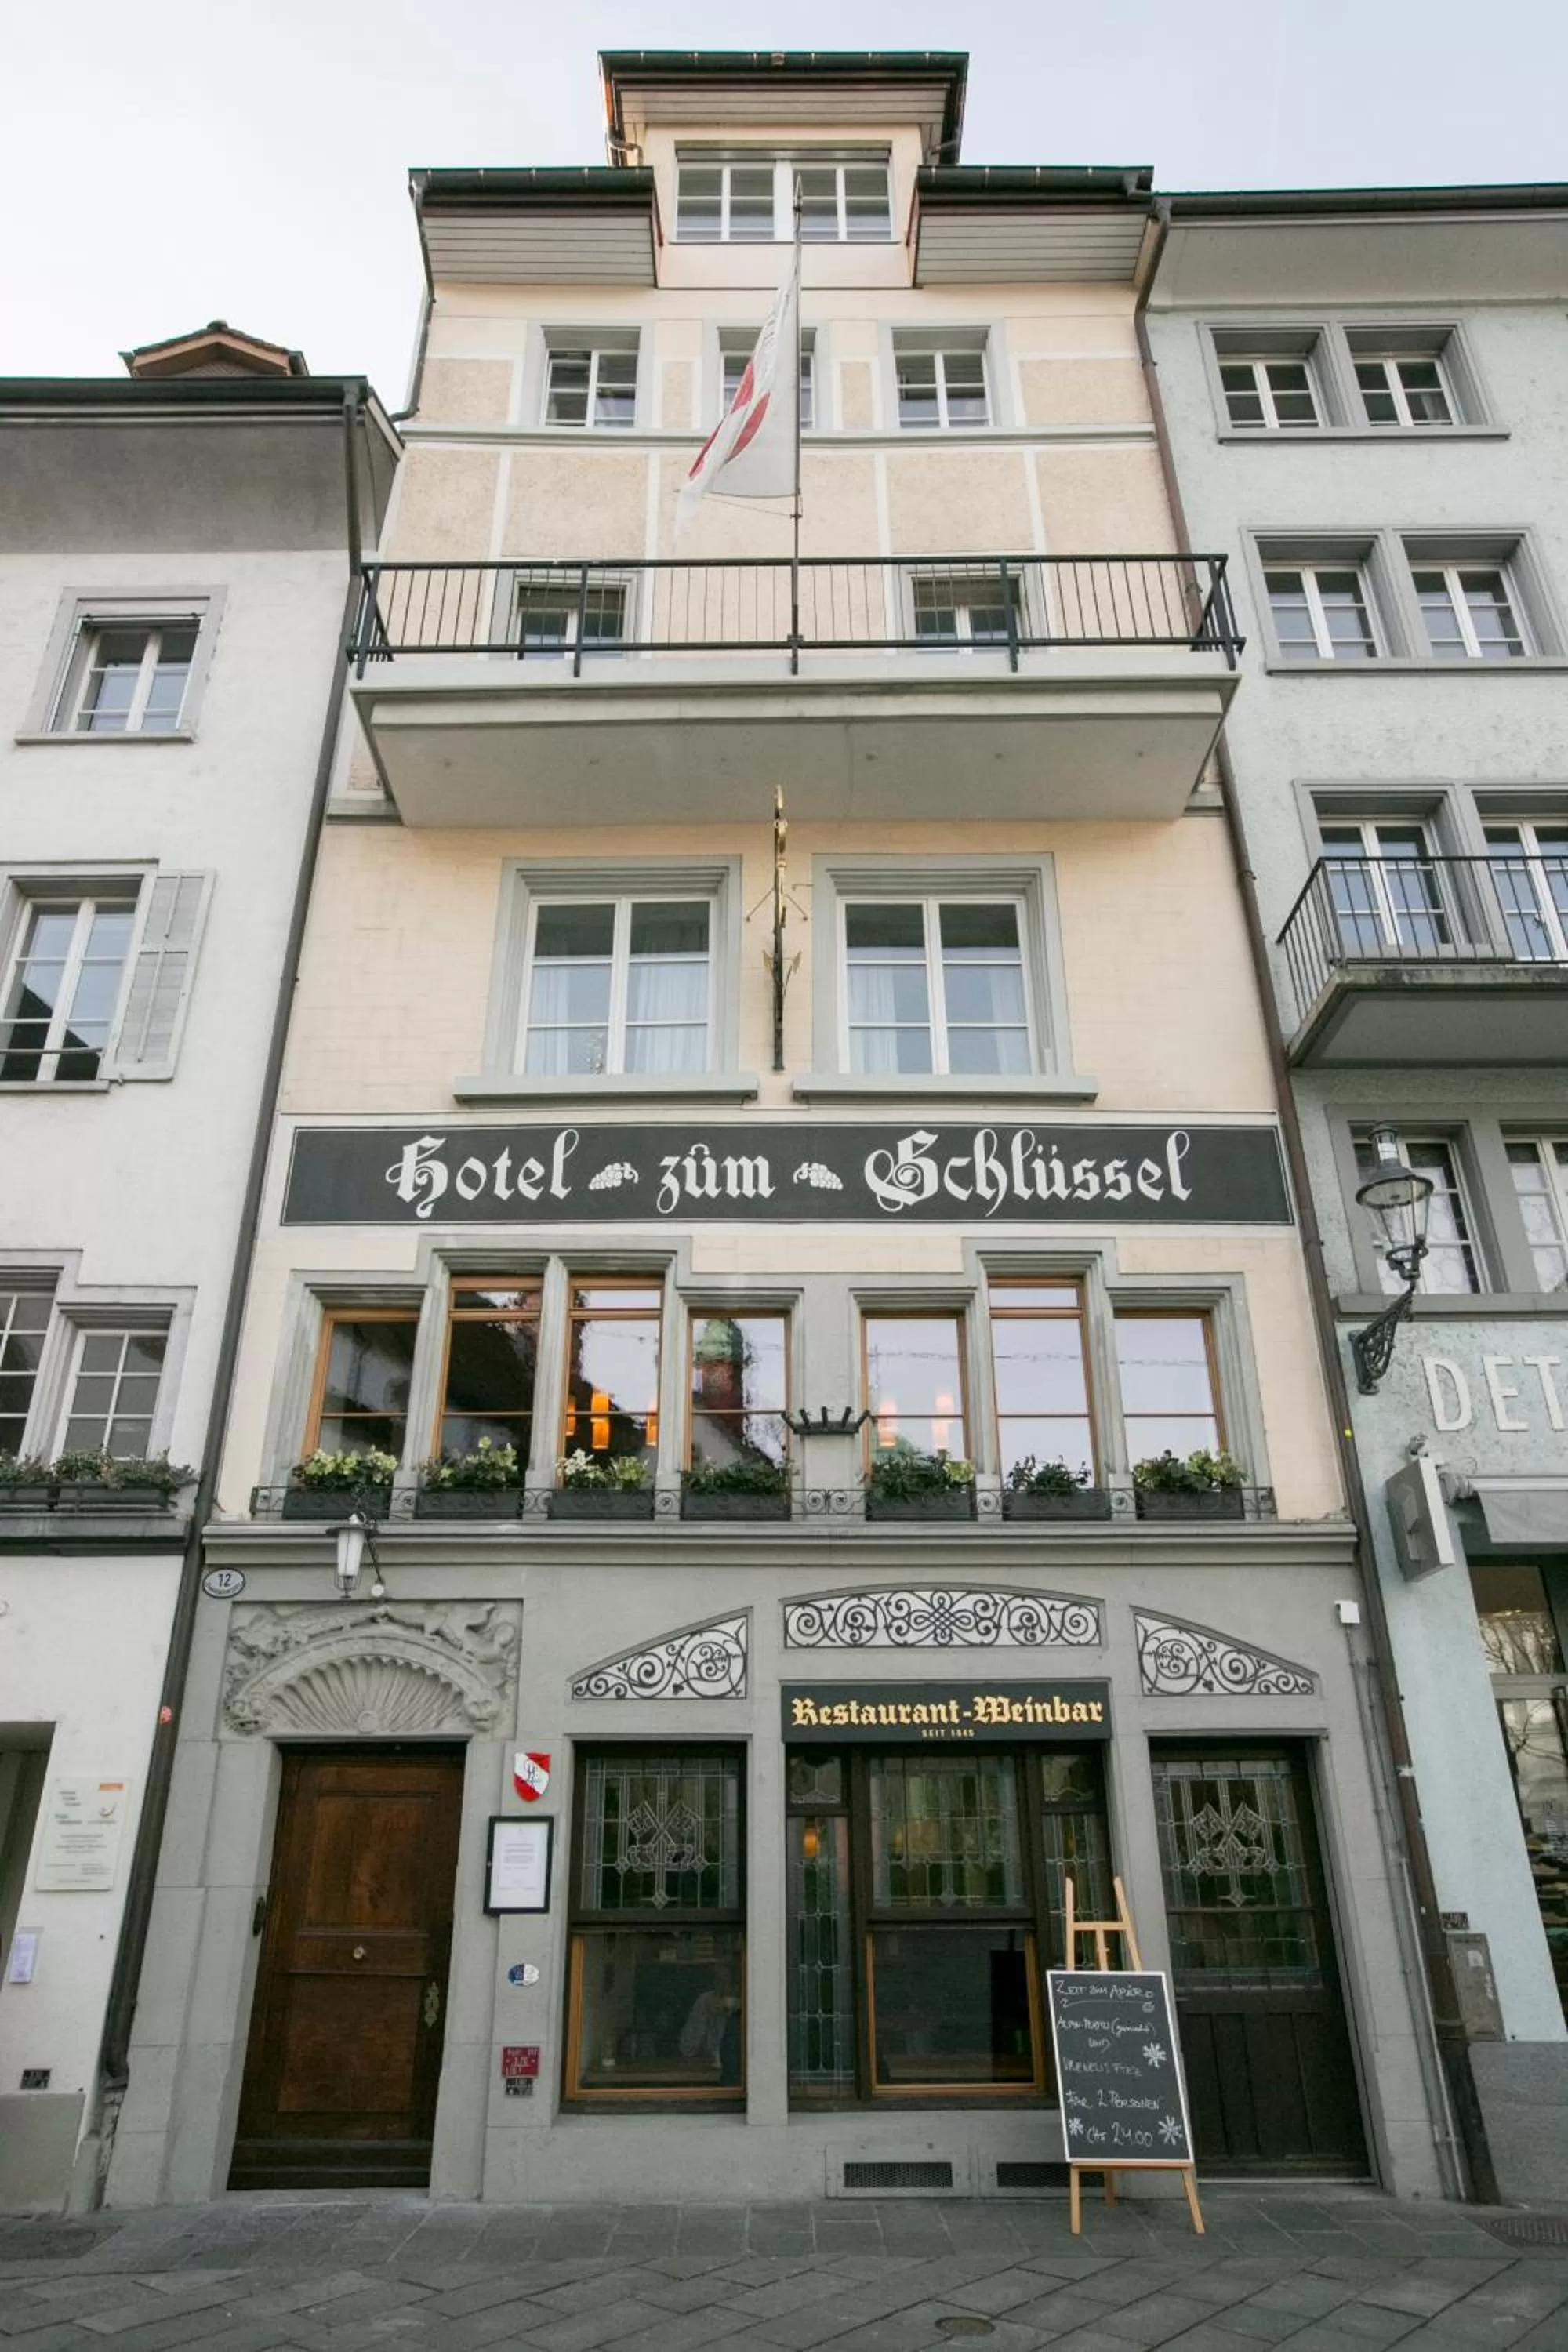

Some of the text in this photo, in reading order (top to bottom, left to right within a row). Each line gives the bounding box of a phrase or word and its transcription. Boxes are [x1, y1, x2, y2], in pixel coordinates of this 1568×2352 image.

[385, 1128, 579, 1218] Hotel
[864, 1129, 1192, 1217] Schlüssel
[218, 1573, 232, 1588] 12
[921, 1729, 946, 1738] SEIT
[1097, 2089, 1109, 2107] 2
